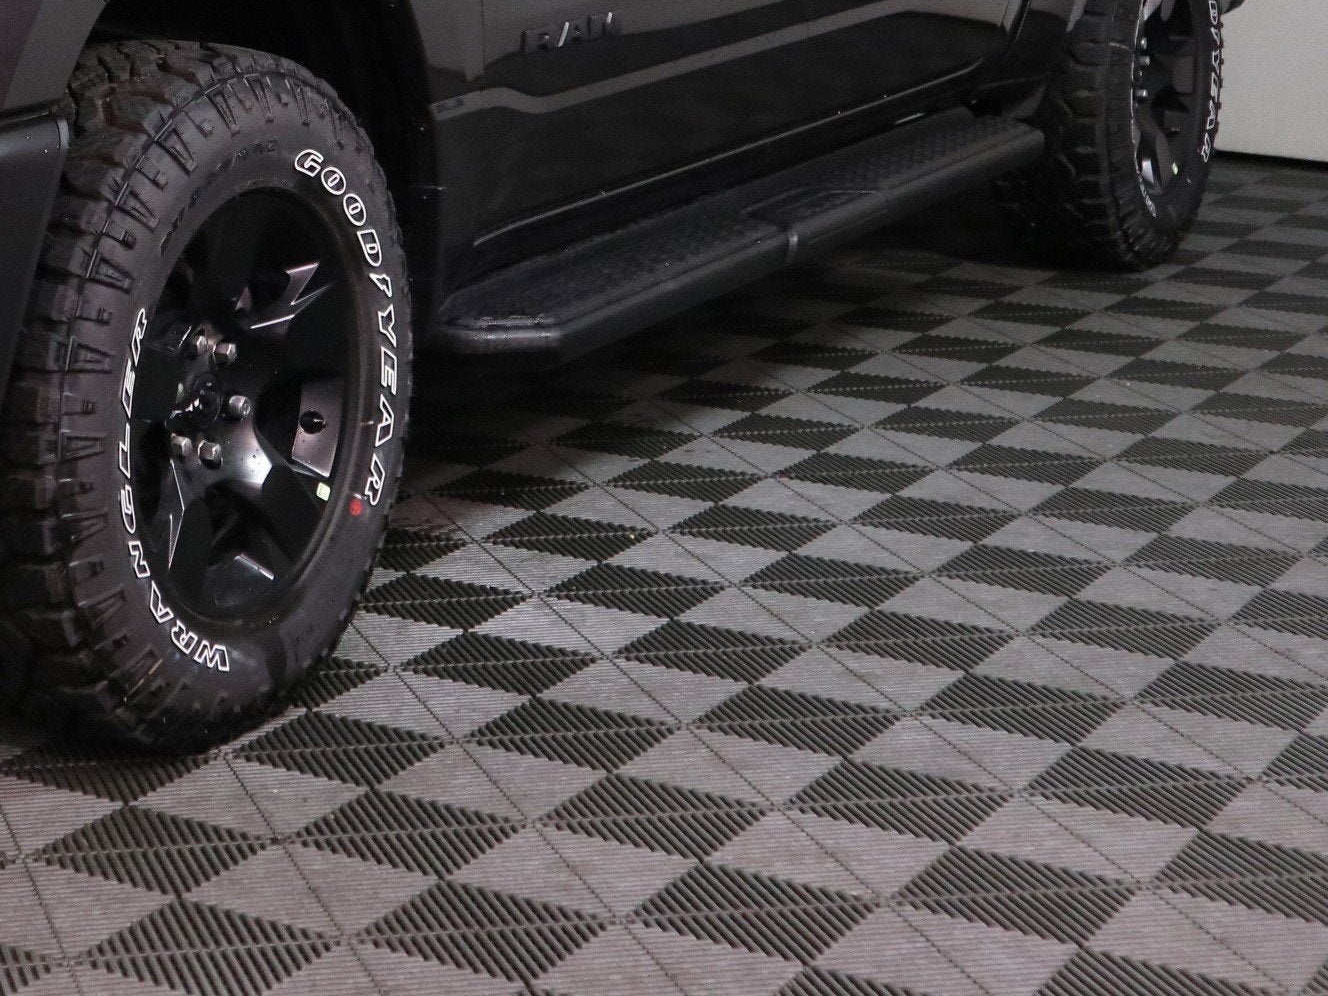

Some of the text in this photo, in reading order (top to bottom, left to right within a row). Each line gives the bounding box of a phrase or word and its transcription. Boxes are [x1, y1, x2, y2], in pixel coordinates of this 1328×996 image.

[520, 9, 623, 54] RAM
[118, 308, 230, 673] WRANGLER
[293, 149, 398, 506] GOODYEAR
